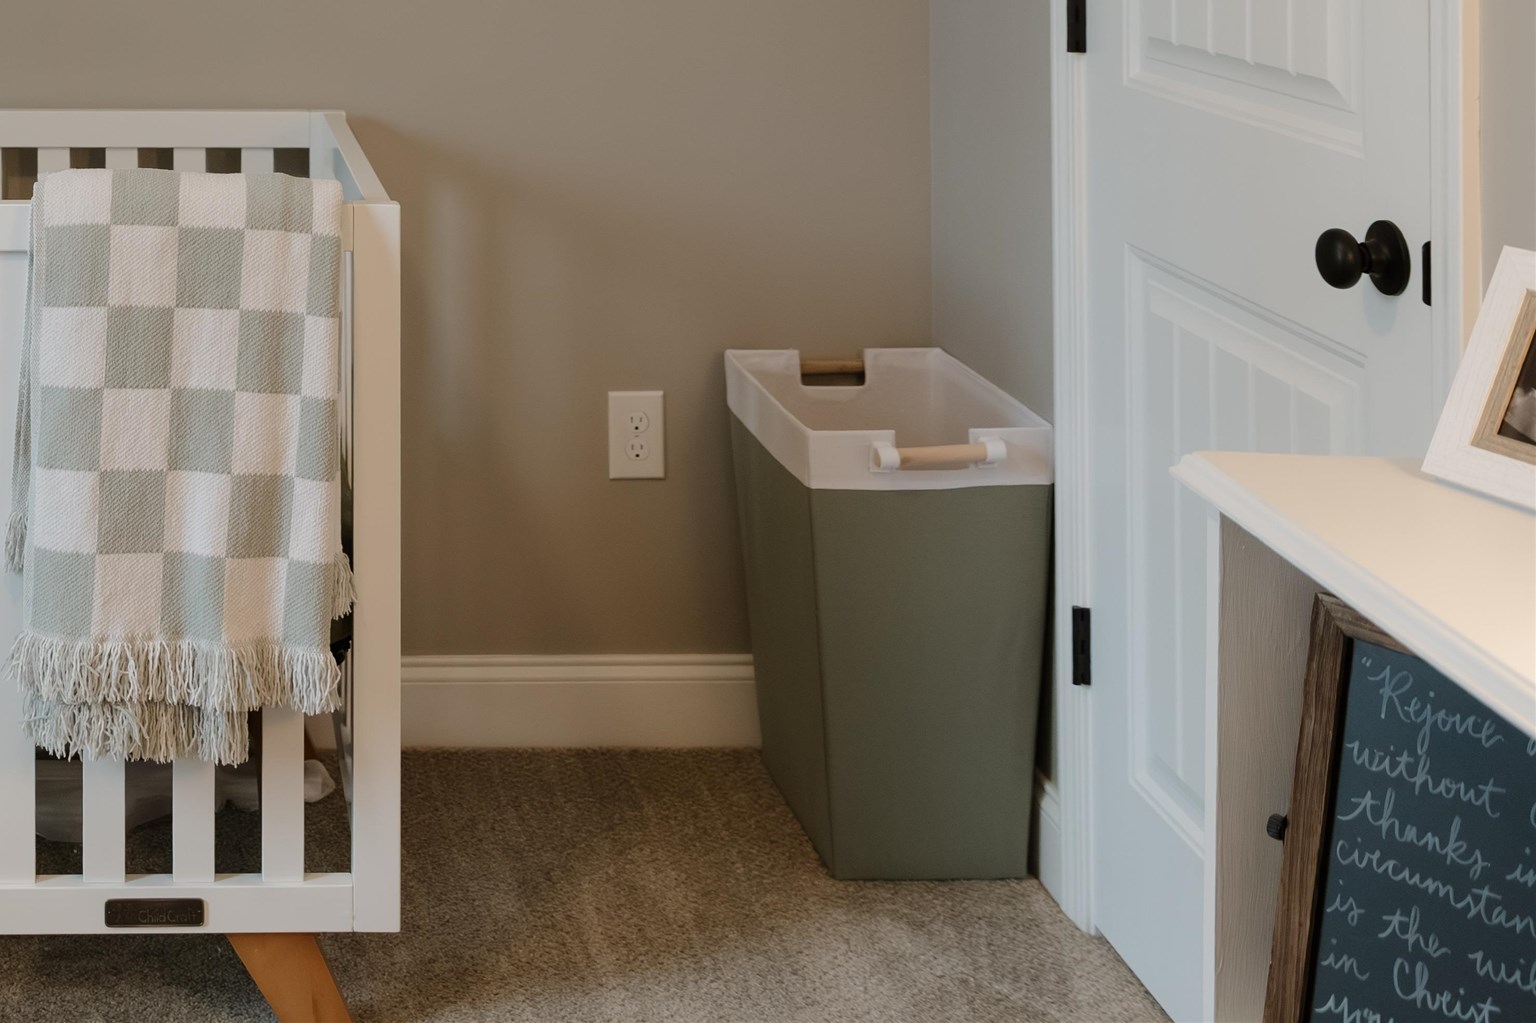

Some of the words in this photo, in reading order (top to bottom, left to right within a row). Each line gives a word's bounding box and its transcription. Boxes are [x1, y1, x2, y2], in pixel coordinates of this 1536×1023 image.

[1345, 739, 1507, 818] without
[1337, 786, 1491, 881] thanks
[1326, 878, 1366, 927] is
[1377, 904, 1452, 959] the
[1321, 937, 1371, 982] in
[1392, 956, 1502, 1023] Christ
